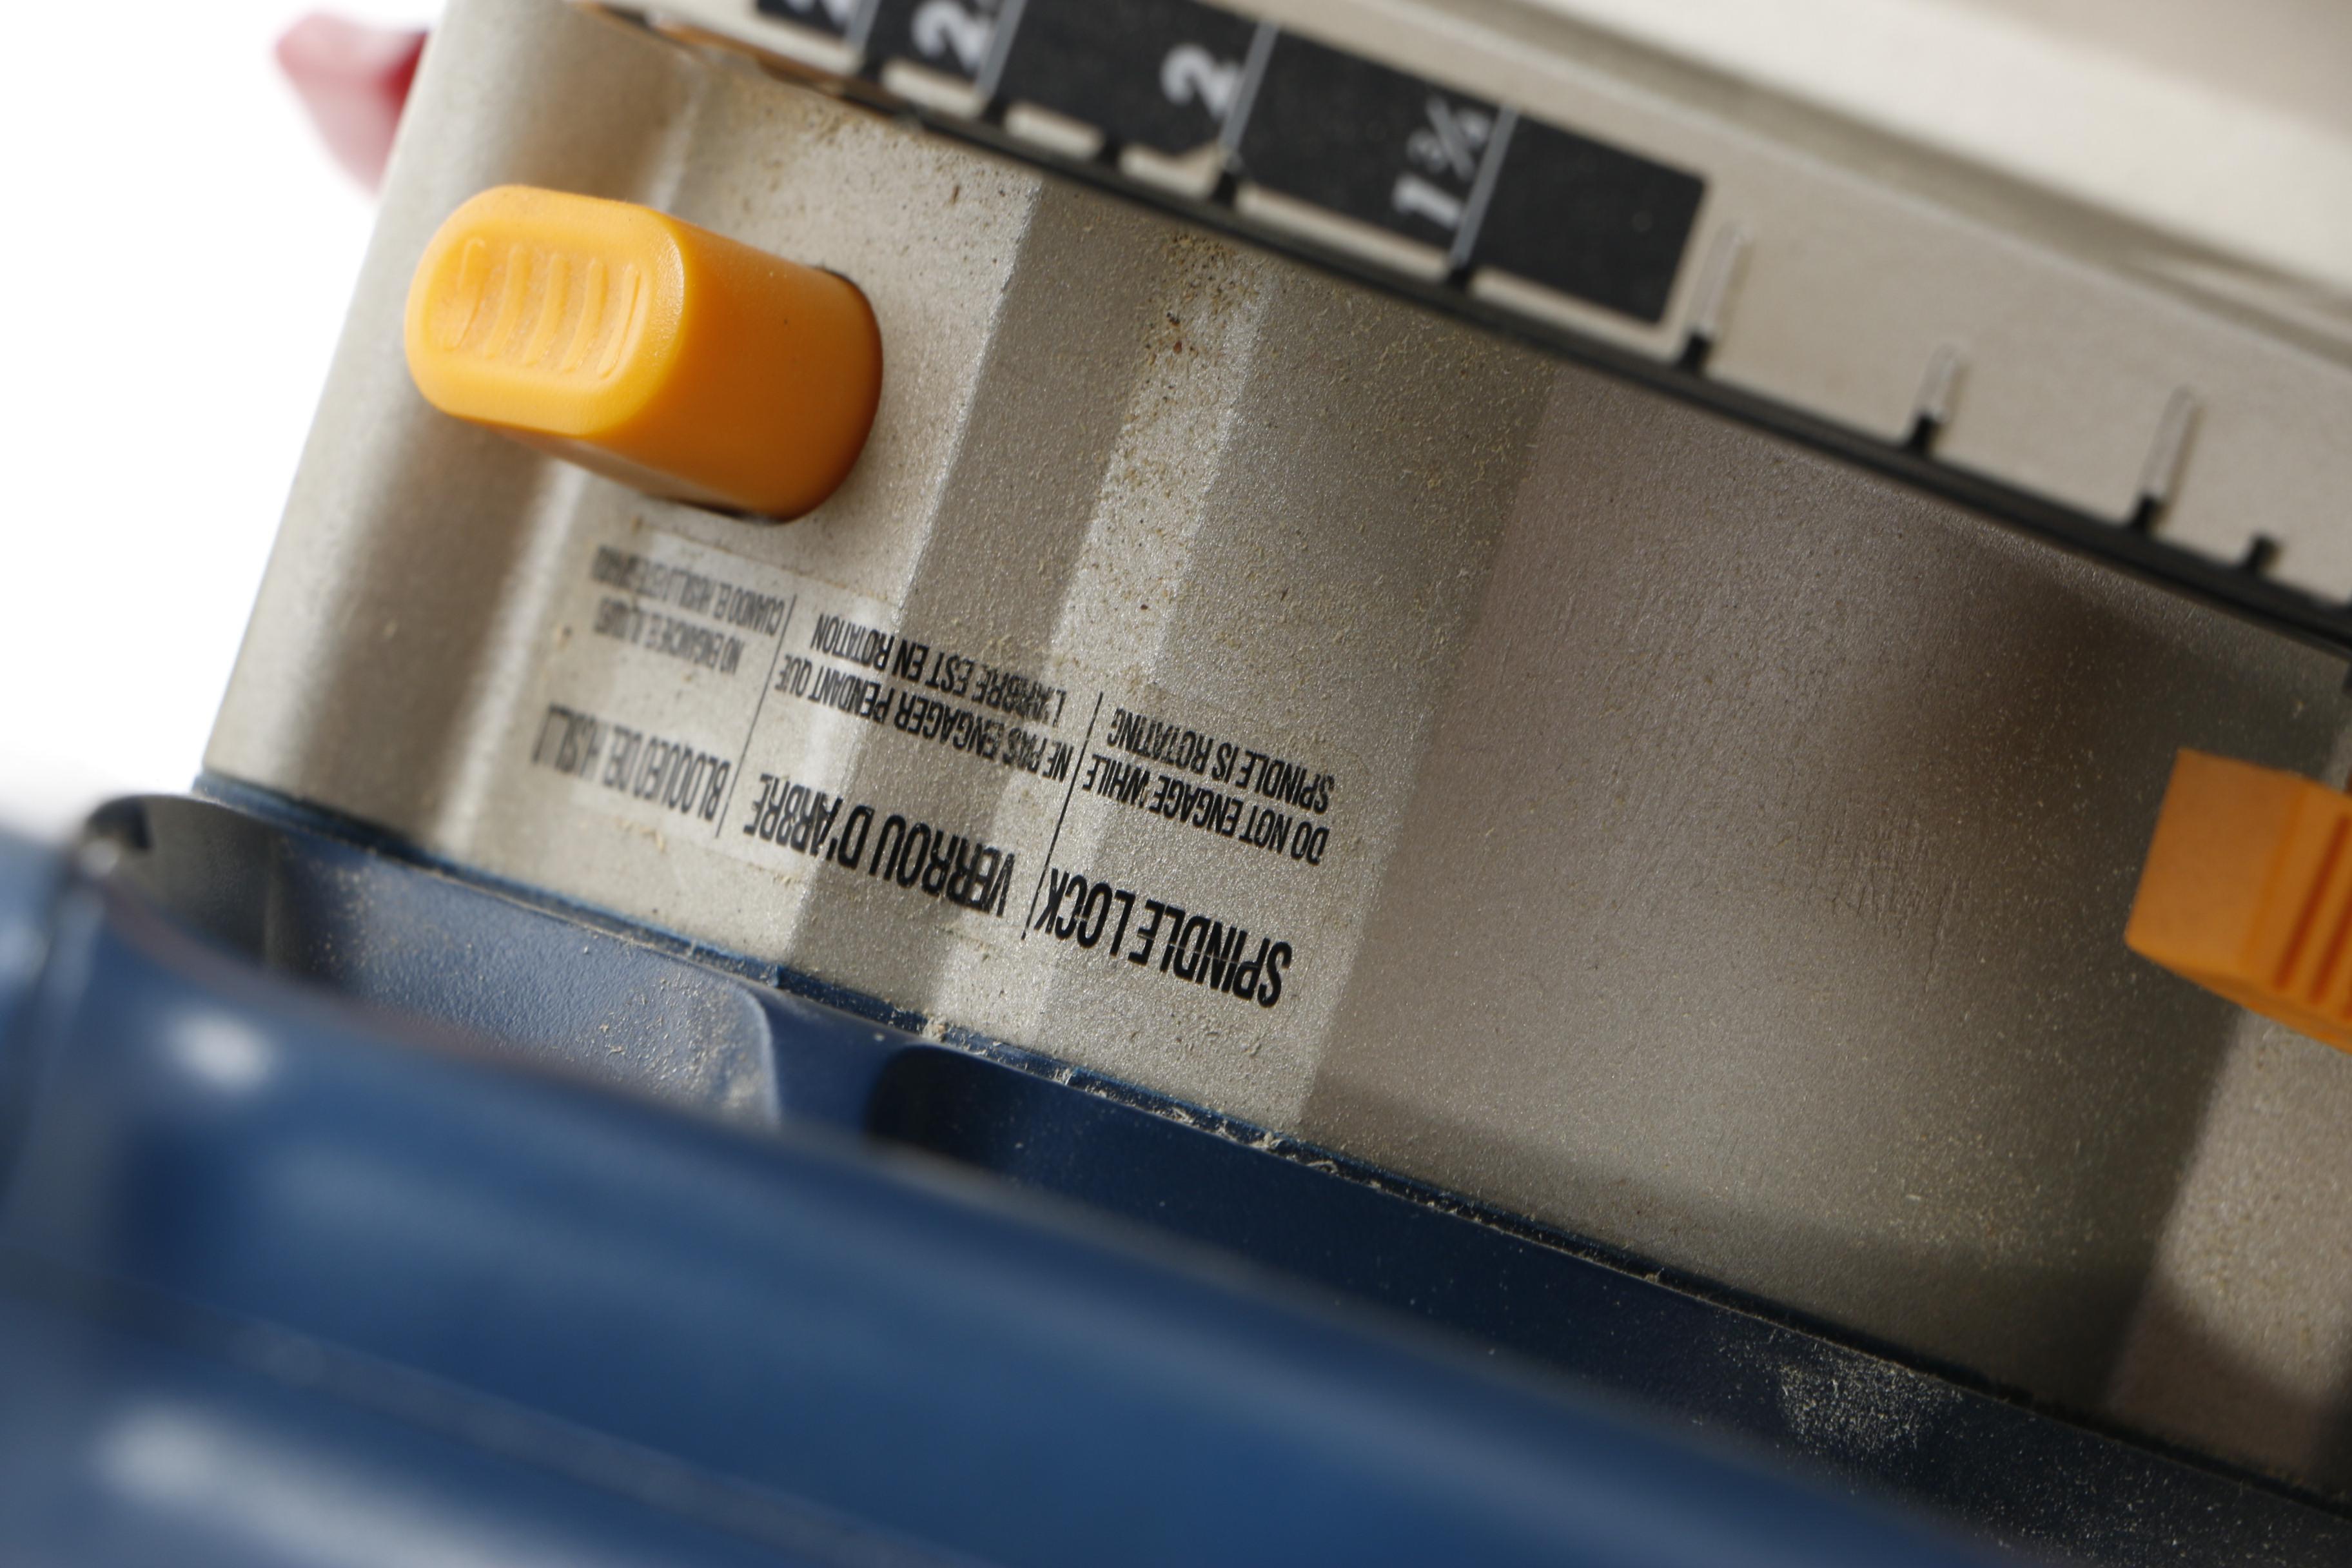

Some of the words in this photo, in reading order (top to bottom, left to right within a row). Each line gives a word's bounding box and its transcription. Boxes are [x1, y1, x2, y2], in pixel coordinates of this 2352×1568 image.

[912, 0, 997, 71] 2
[1162, 43, 1244, 121] 2
[809, 612, 894, 671] ROTATION
[891, 638, 929, 682] EN
[774, 654, 813, 696] QUE
[807, 664, 895, 724] PENDANT
[924, 651, 974, 698] EST
[970, 665, 1066, 728] L'ARBRE
[891, 691, 1004, 761] ENGAGER
[1000, 726, 1047, 774] PAS
[1104, 707, 1213, 776] ROTATING
[631, 736, 730, 821] BLOQUEO
[1041, 740, 1074, 783] NE
[1081, 753, 1151, 808] WHILE
[1210, 740, 1239, 783] IS
[1234, 750, 1333, 816] SPINDLE
[742, 773, 874, 869] D'ARBRE
[1147, 773, 1244, 839] ENGAGE
[1238, 805, 1291, 854] NOT
[868, 812, 1014, 917] VERROU
[1287, 819, 1329, 867] DO
[1033, 867, 1135, 956] LOCK
[1127, 899, 1295, 1010] SPINDLE
